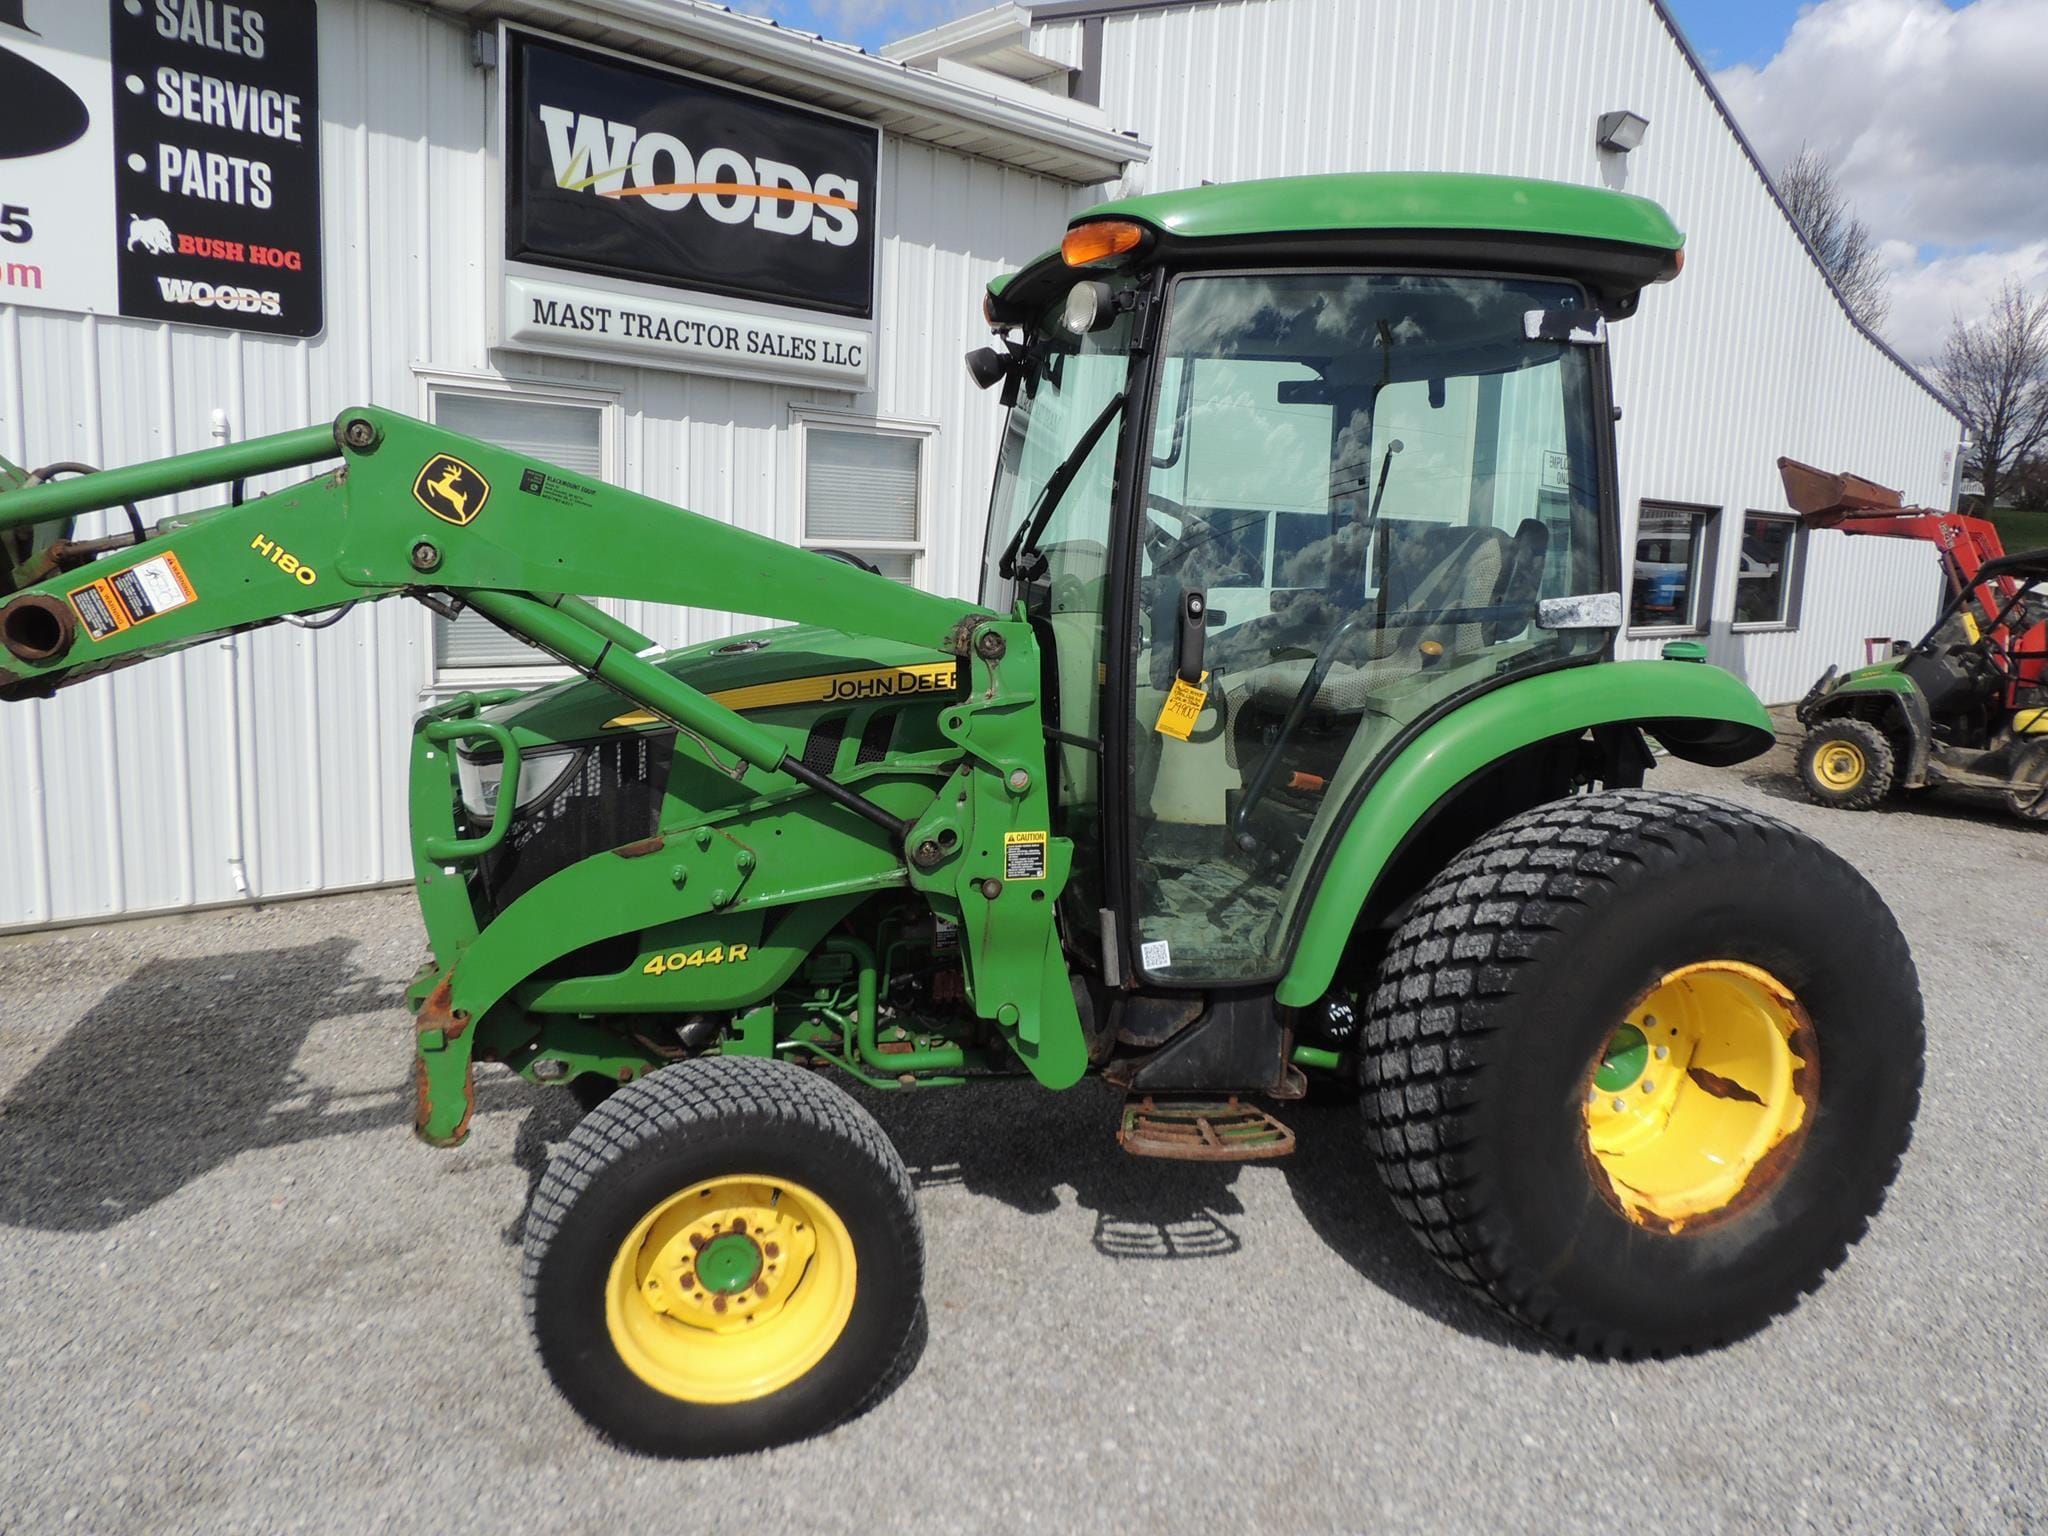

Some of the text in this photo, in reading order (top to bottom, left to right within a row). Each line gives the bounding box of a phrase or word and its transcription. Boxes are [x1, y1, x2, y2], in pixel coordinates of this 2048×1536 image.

[154, 0, 264, 59] SALES
[157, 66, 302, 143] SERVICE
[158, 143, 272, 210] PARTS
[540, 104, 859, 246] WOODS
[177, 233, 302, 271] BUSH HOG
[158, 276, 281, 316] WOODS
[532, 298, 862, 367] MAST TRACTOR SALES LLC
[171, 565, 192, 597] WARNING
[250, 533, 317, 586] H180
[103, 593, 124, 625] WARNING
[822, 676, 893, 700] JOHN
[1016, 833, 1044, 842] CAUTION
